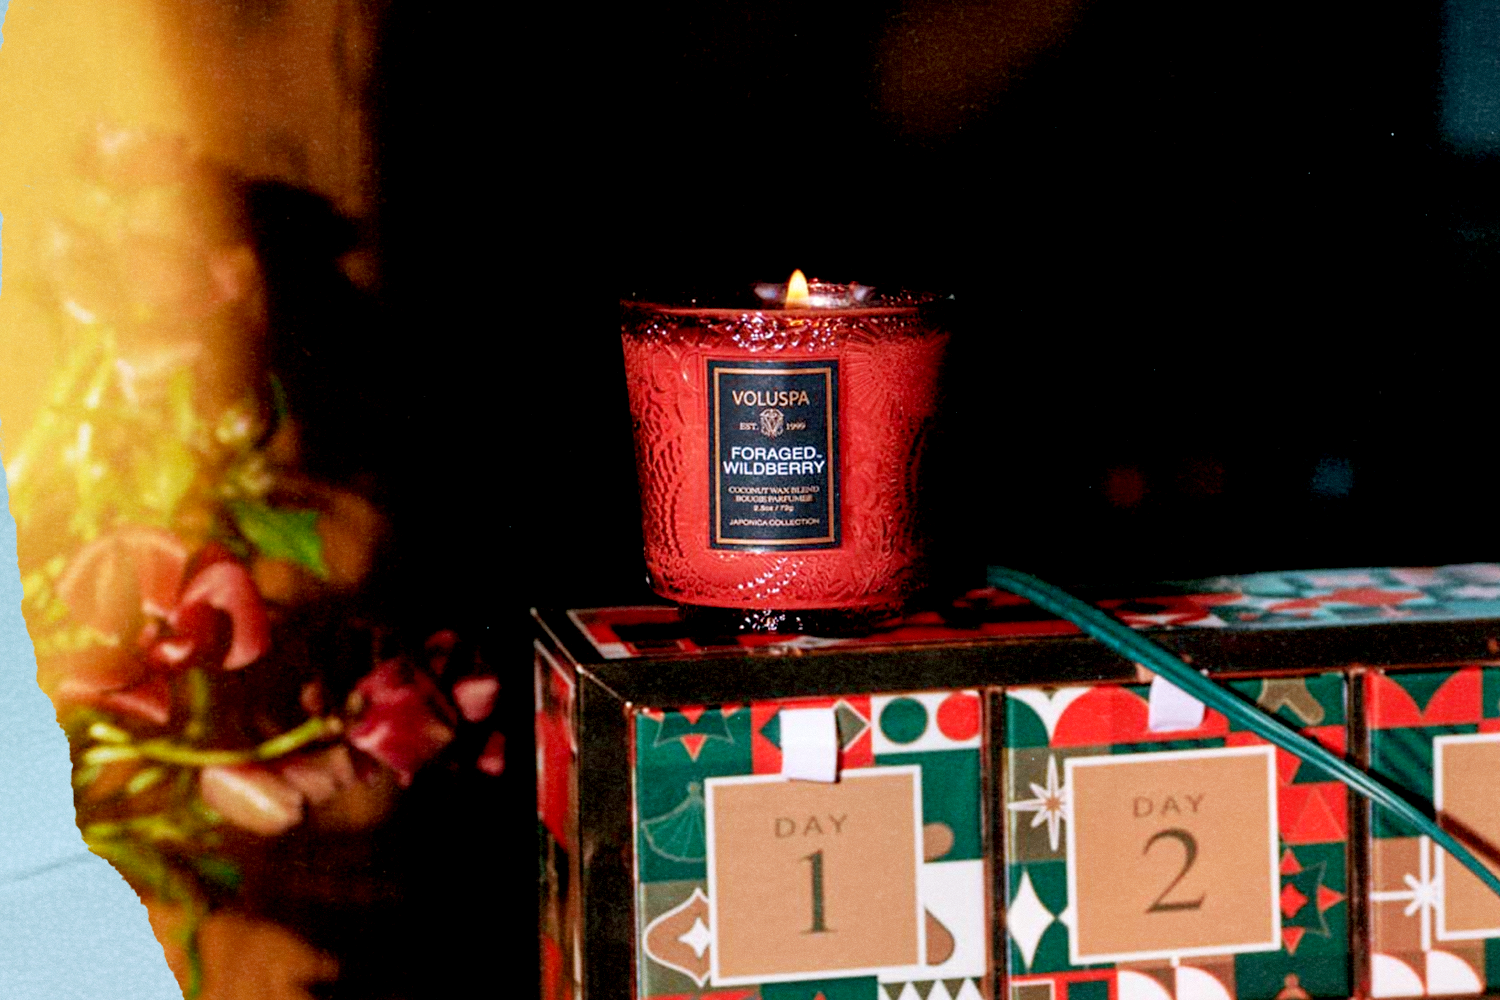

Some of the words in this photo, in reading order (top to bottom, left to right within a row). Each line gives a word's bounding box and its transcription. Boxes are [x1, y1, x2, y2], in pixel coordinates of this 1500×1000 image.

[732, 389, 810, 407] VOLUSPA
[723, 460, 825, 475] WILDBERRY
[1133, 793, 1206, 818] DAY
[774, 813, 848, 838] DAY
[1142, 827, 1207, 914] 2
[799, 849, 838, 934] 1
